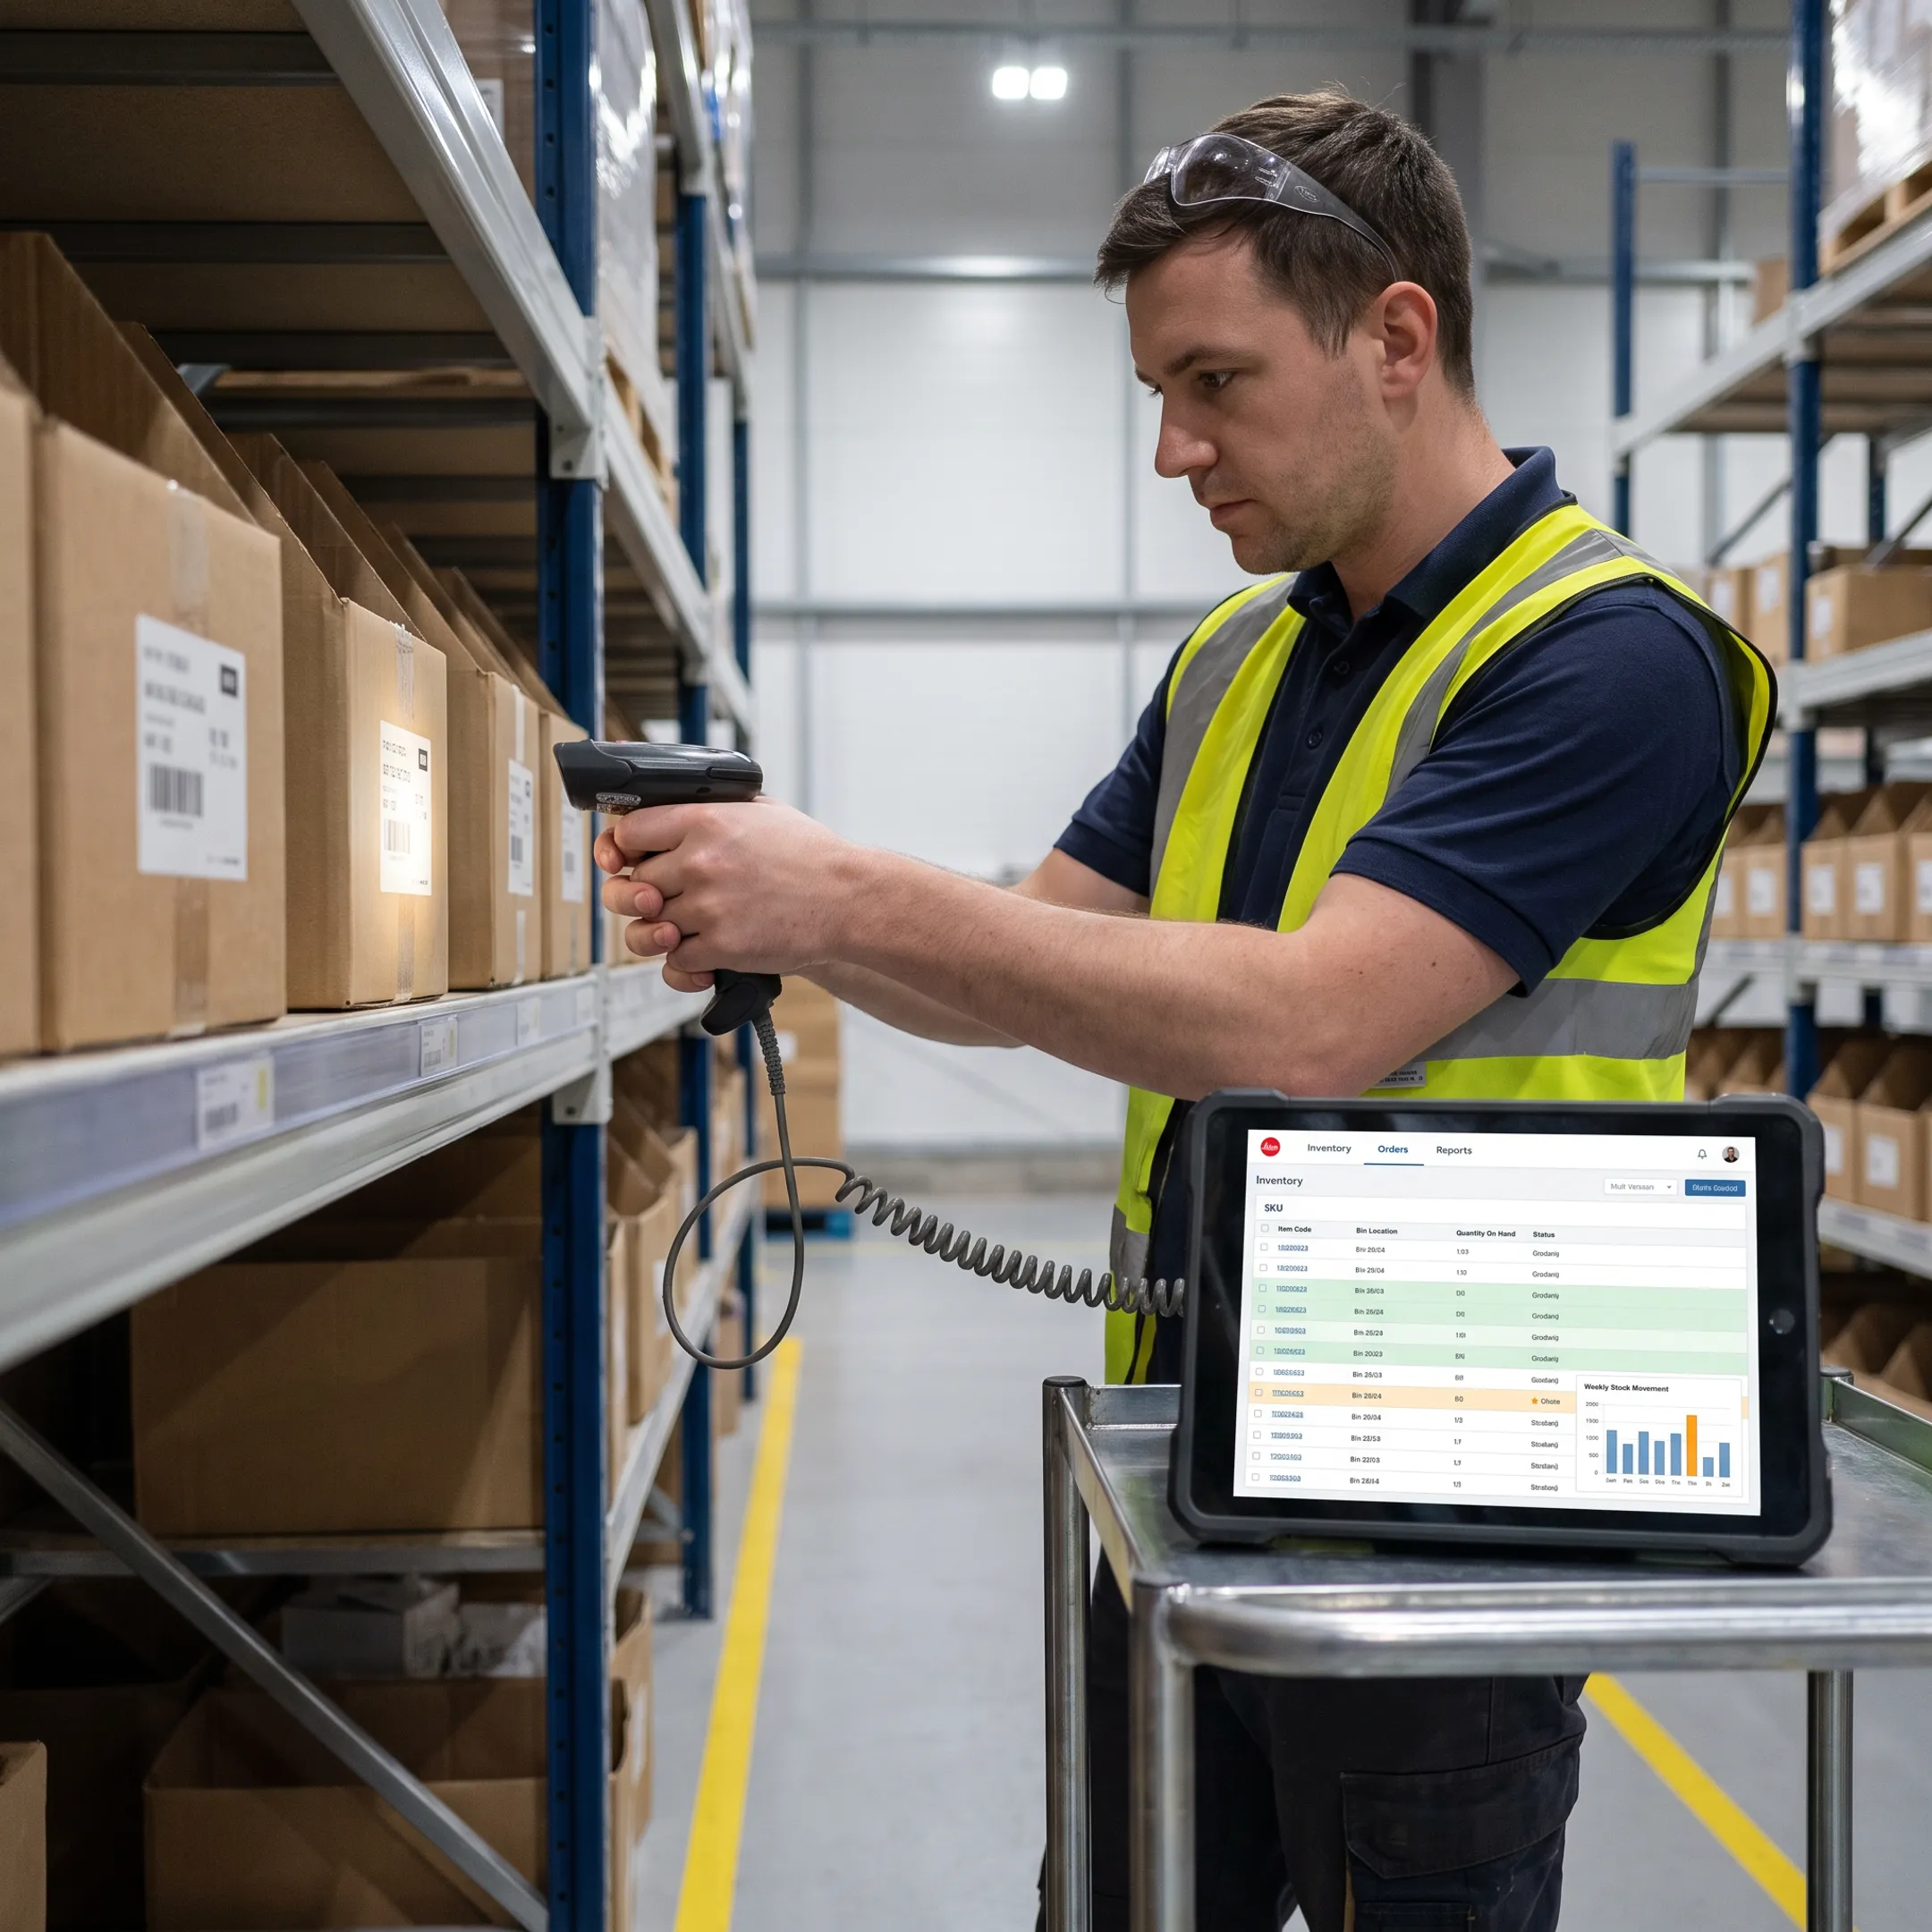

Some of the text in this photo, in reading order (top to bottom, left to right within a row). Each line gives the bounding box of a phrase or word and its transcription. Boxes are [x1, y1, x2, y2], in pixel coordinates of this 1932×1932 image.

[1307, 1143, 1352, 1154] Inventory
[1377, 1145, 1409, 1154] Orders
[1436, 1146, 1472, 1156] Reports
[1256, 1175, 1303, 1187] Inventory
[1264, 1204, 1284, 1212] SKU
